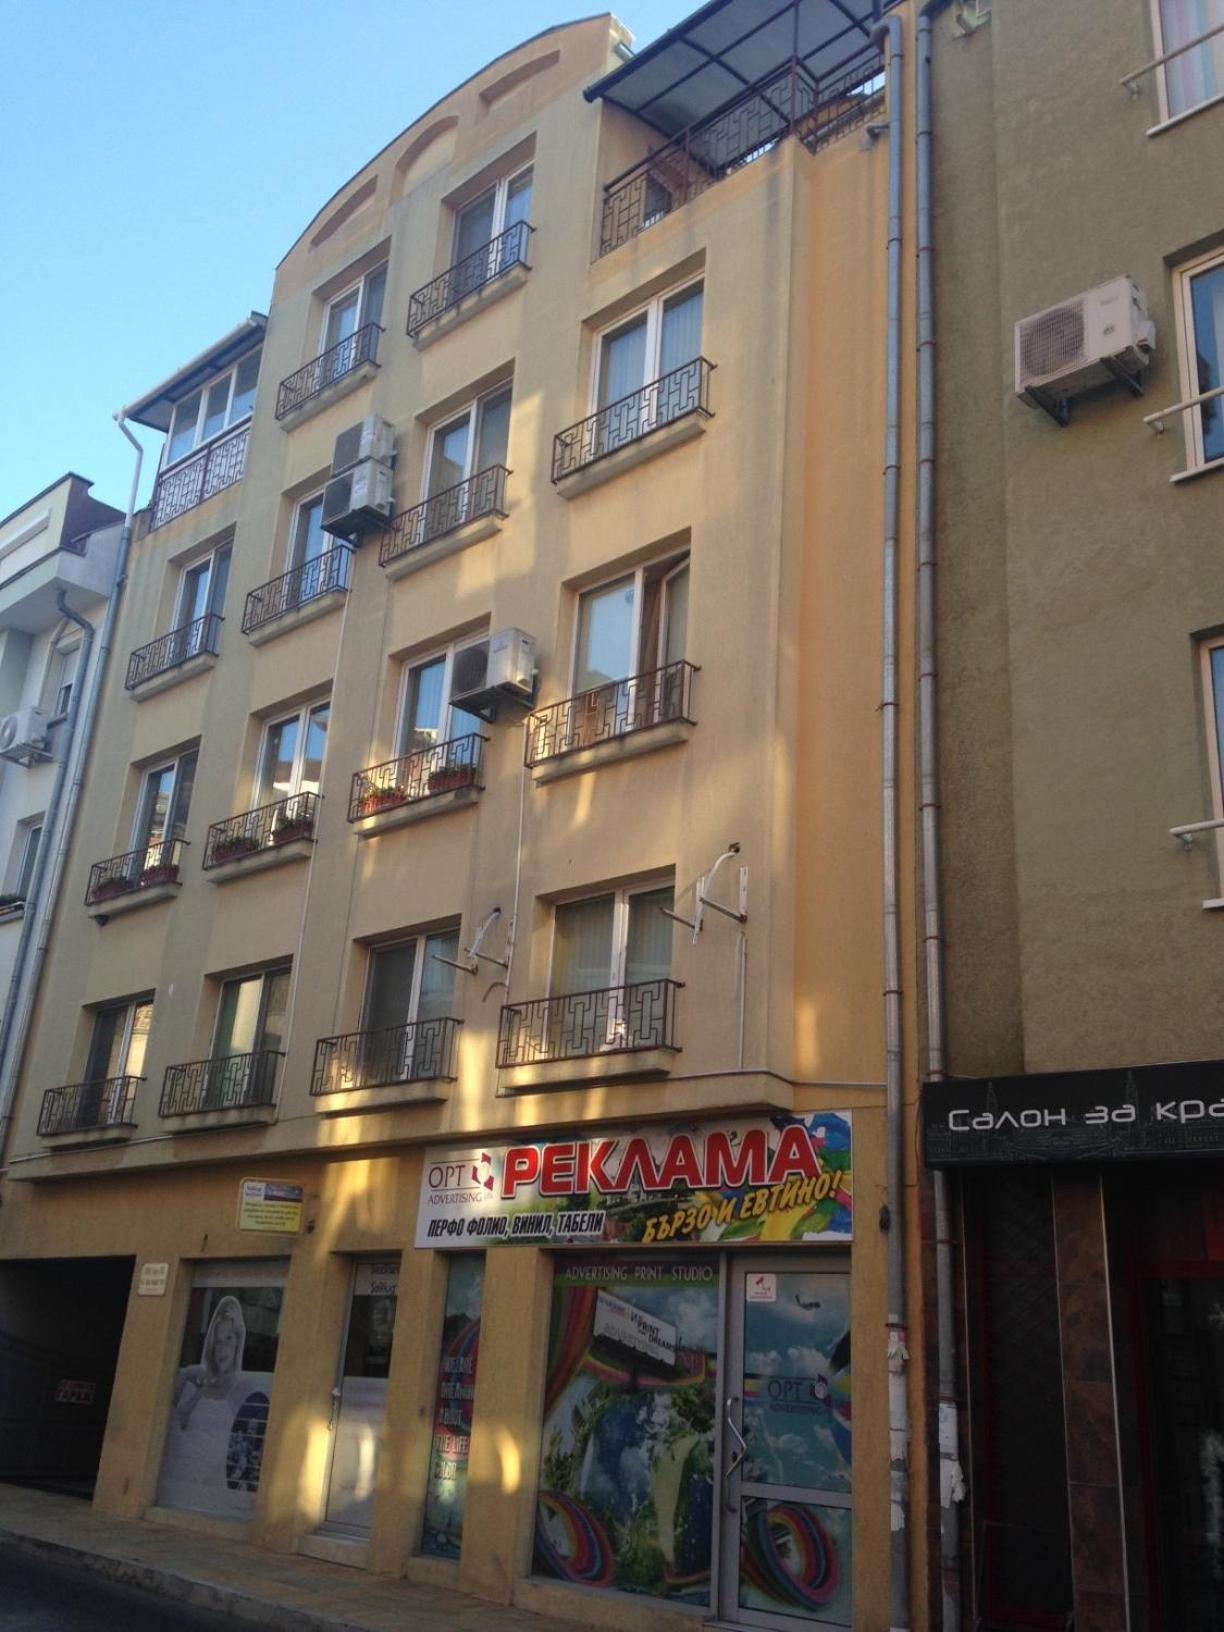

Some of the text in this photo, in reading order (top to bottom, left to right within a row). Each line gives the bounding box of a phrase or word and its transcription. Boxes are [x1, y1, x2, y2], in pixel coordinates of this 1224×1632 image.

[948, 1108, 1067, 1131] Салон
[1084, 1103, 1137, 1124] за
[501, 1124, 822, 1199] РЕКЛАМА
[428, 1164, 466, 1188] OPT
[427, 1192, 482, 1206] ADVERTISING
[642, 1172, 841, 1243] БЪРЗО И ЕВТИНО!
[427, 1212, 604, 1237] ПЕРФО ФОЛИО, ВИНИЛ, ТАБЕЛИ
[564, 1266, 713, 1282] ADVERTISING PRINT STUDIO
